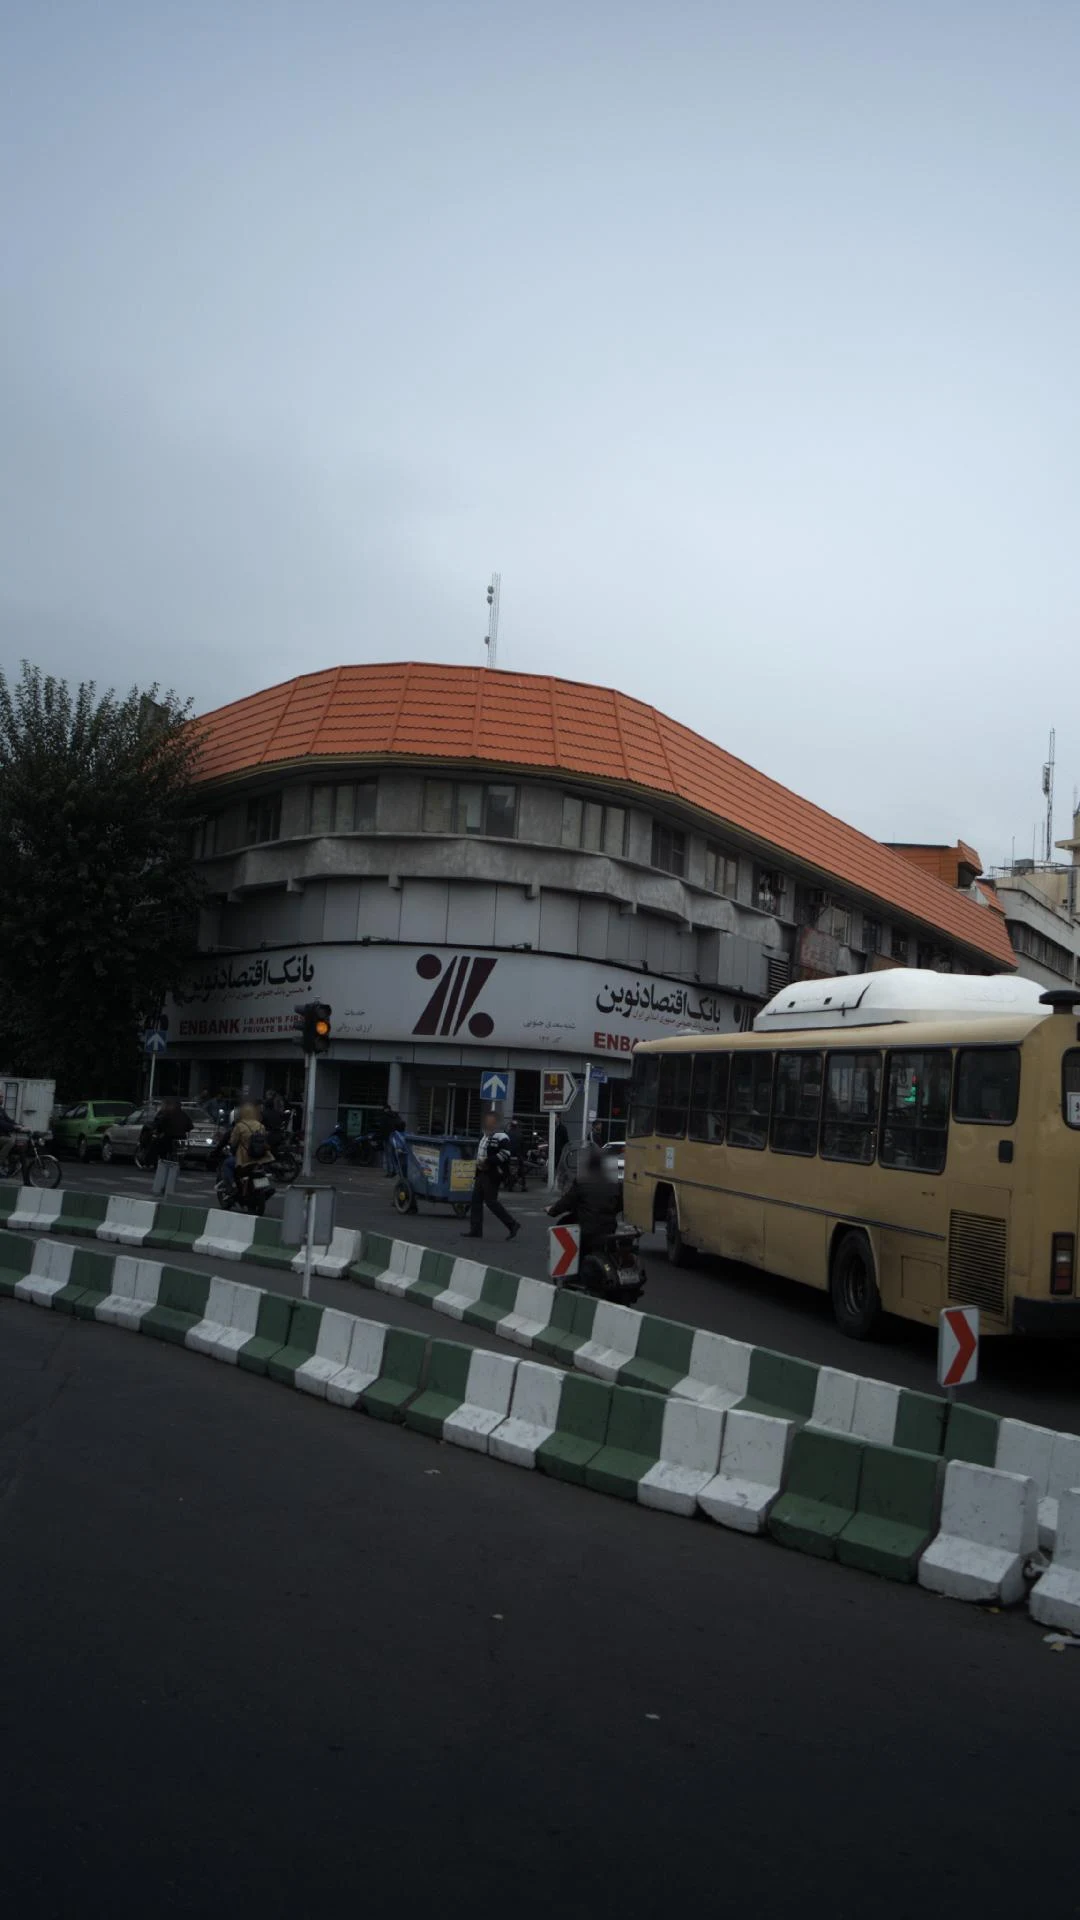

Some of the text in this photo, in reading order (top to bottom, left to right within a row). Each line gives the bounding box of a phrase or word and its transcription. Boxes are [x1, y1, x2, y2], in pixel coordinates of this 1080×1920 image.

[219, 959, 269, 990] اقتصاد
[268, 954, 314, 991] بانک
[596, 981, 721, 1032] بانک اقتصاد نوین
[179, 1019, 240, 1036] ENBANK
[278, 1024, 297, 1033] BAN
[285, 1015, 305, 1024] FIRS
[593, 1032, 640, 1053] ENB
